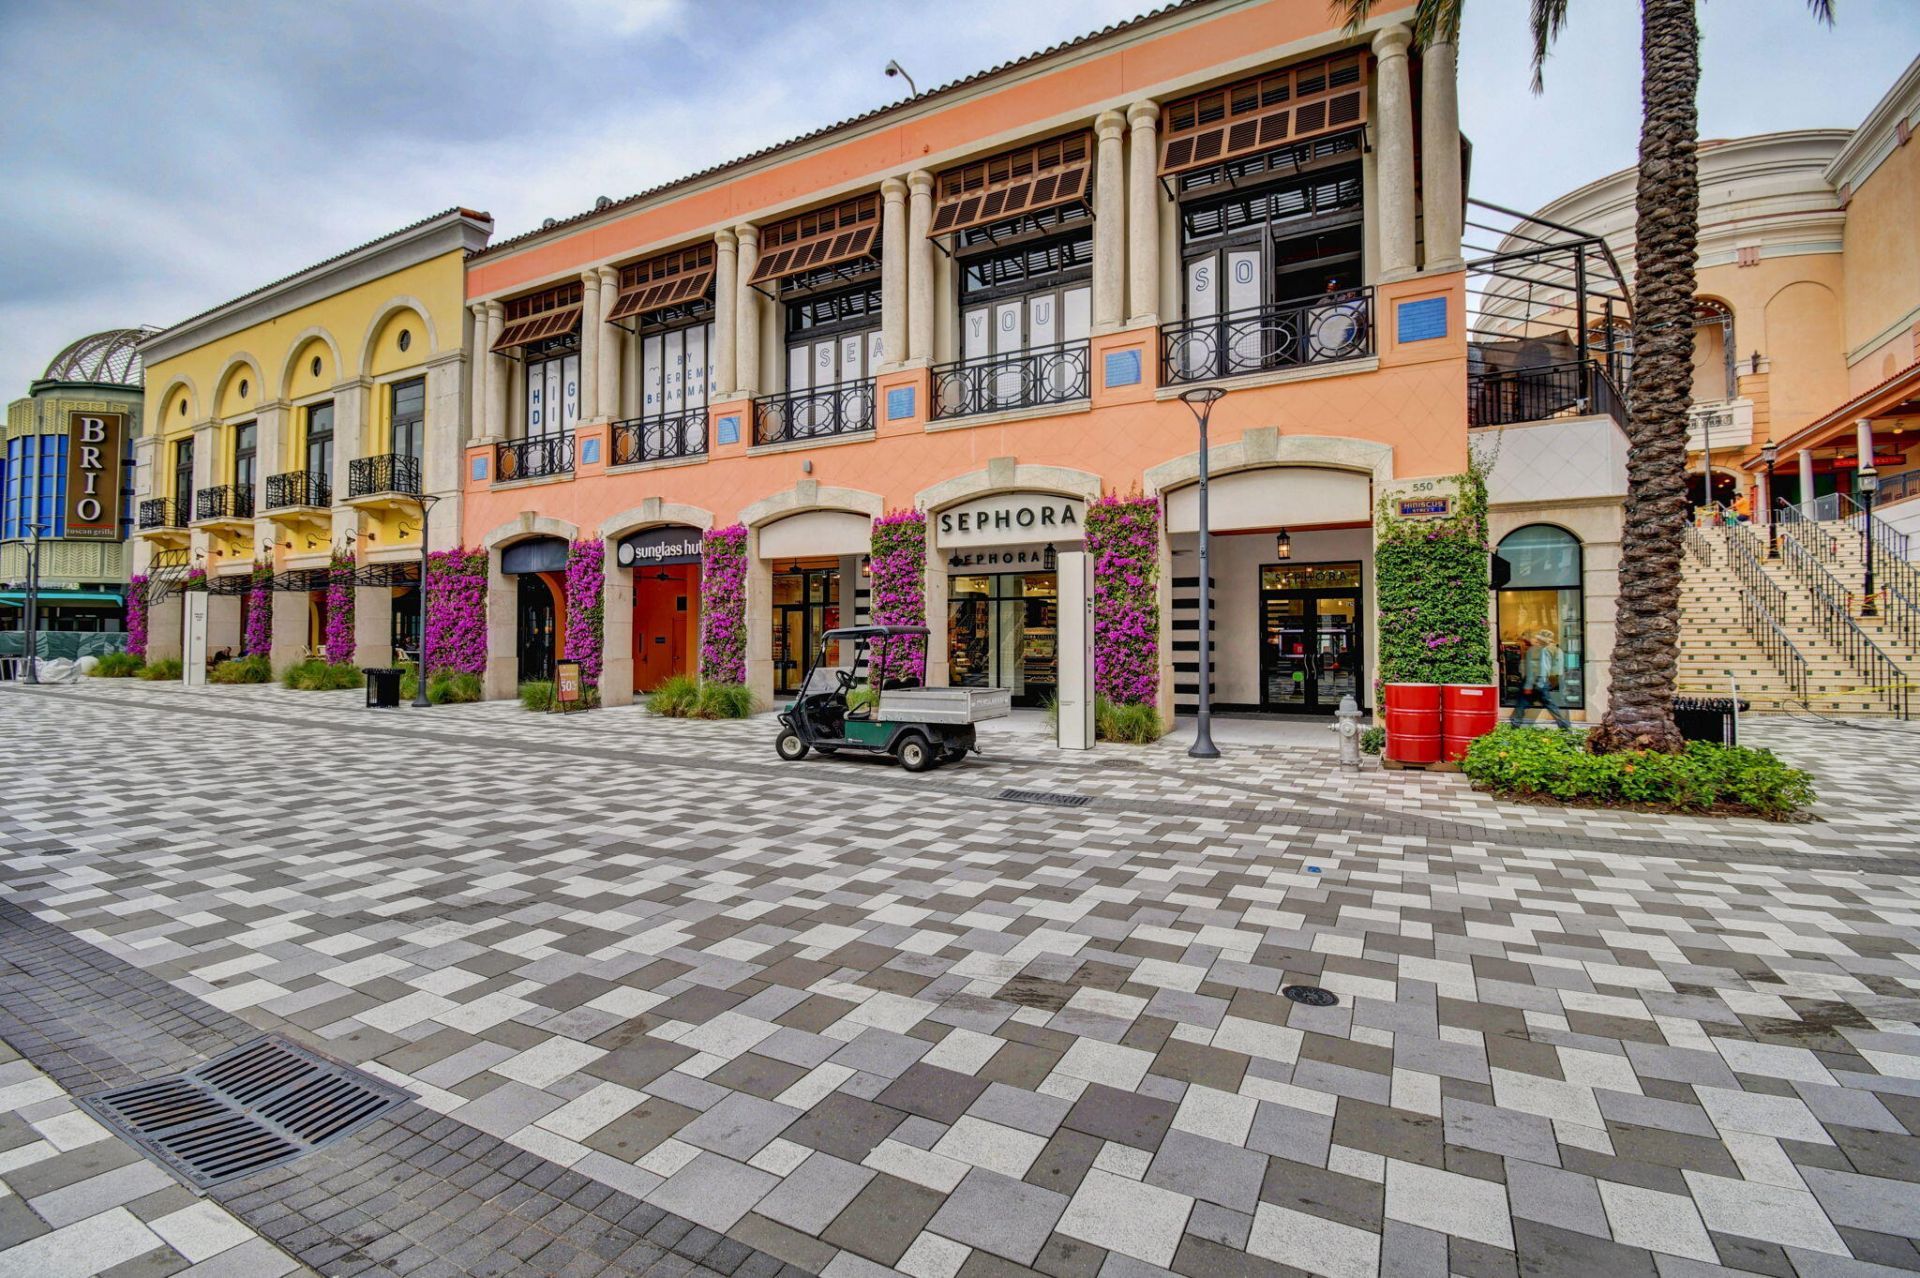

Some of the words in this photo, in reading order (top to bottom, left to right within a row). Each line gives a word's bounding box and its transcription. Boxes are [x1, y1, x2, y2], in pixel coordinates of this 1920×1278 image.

[971, 302, 1050, 338] YOU
[677, 352, 693, 366] BY
[819, 337, 884, 368] SEA
[656, 365, 714, 386] JEREMY
[647, 382, 717, 404] BEARMAN
[77, 417, 105, 521] BRIO
[1412, 482, 1434, 492] 550
[941, 504, 1077, 533] SEPHORA
[635, 541, 683, 561] sunglass
[684, 539, 704, 555] hut
[954, 551, 1040, 566] EPHORA
[1274, 571, 1347, 584] SEPHORA
